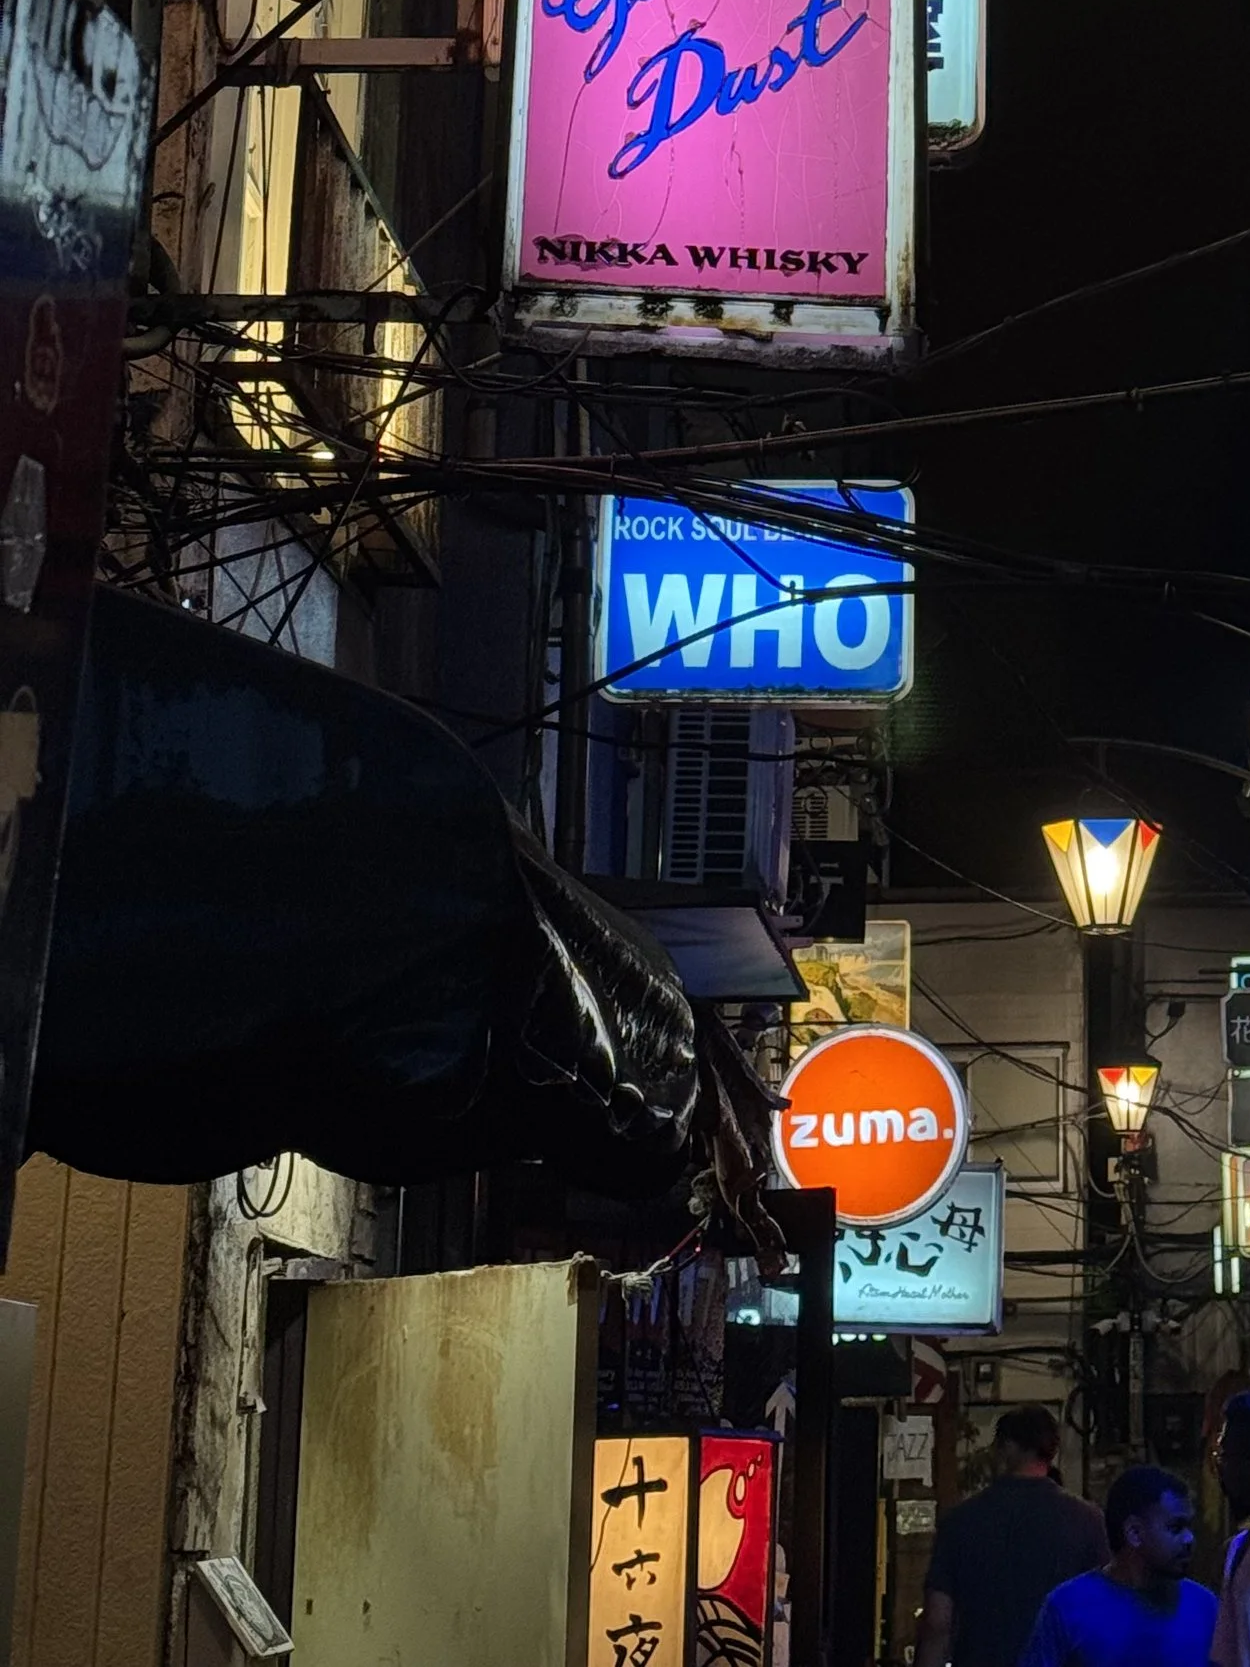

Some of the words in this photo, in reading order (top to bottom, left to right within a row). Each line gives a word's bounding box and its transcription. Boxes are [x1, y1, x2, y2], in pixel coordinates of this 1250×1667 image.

[536, 236, 678, 267] NIKKA
[685, 245, 869, 276] WHISKY
[614, 516, 684, 540] ROCK
[690, 515, 757, 541] SOUL
[623, 573, 890, 670] WHO
[790, 1107, 954, 1149] zuma.
